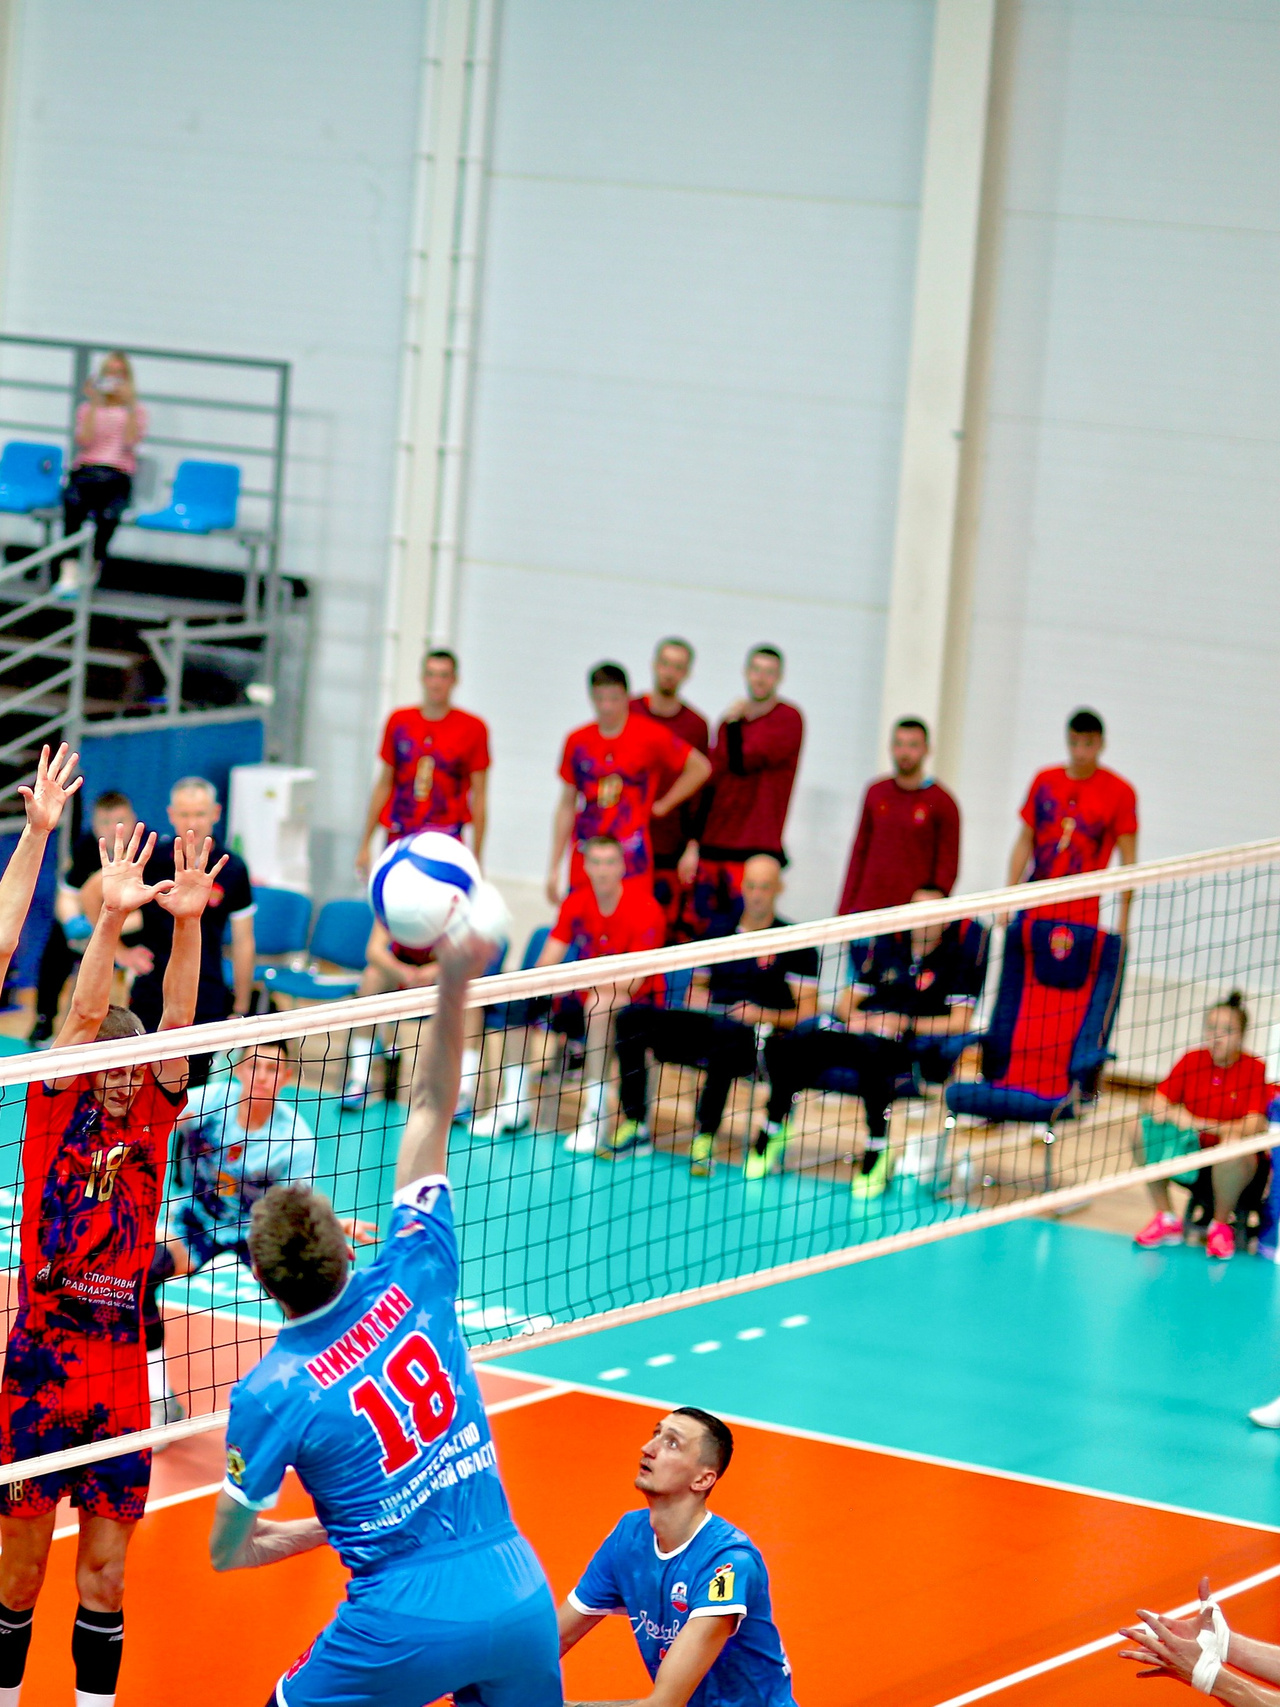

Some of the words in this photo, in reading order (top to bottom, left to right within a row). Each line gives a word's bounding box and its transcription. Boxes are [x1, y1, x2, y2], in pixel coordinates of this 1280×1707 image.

[84, 1145, 131, 1202] 18
[305, 1283, 414, 1388] НИКИТИН
[349, 1331, 459, 1478] 18
[8, 1479, 24, 1501] 18
